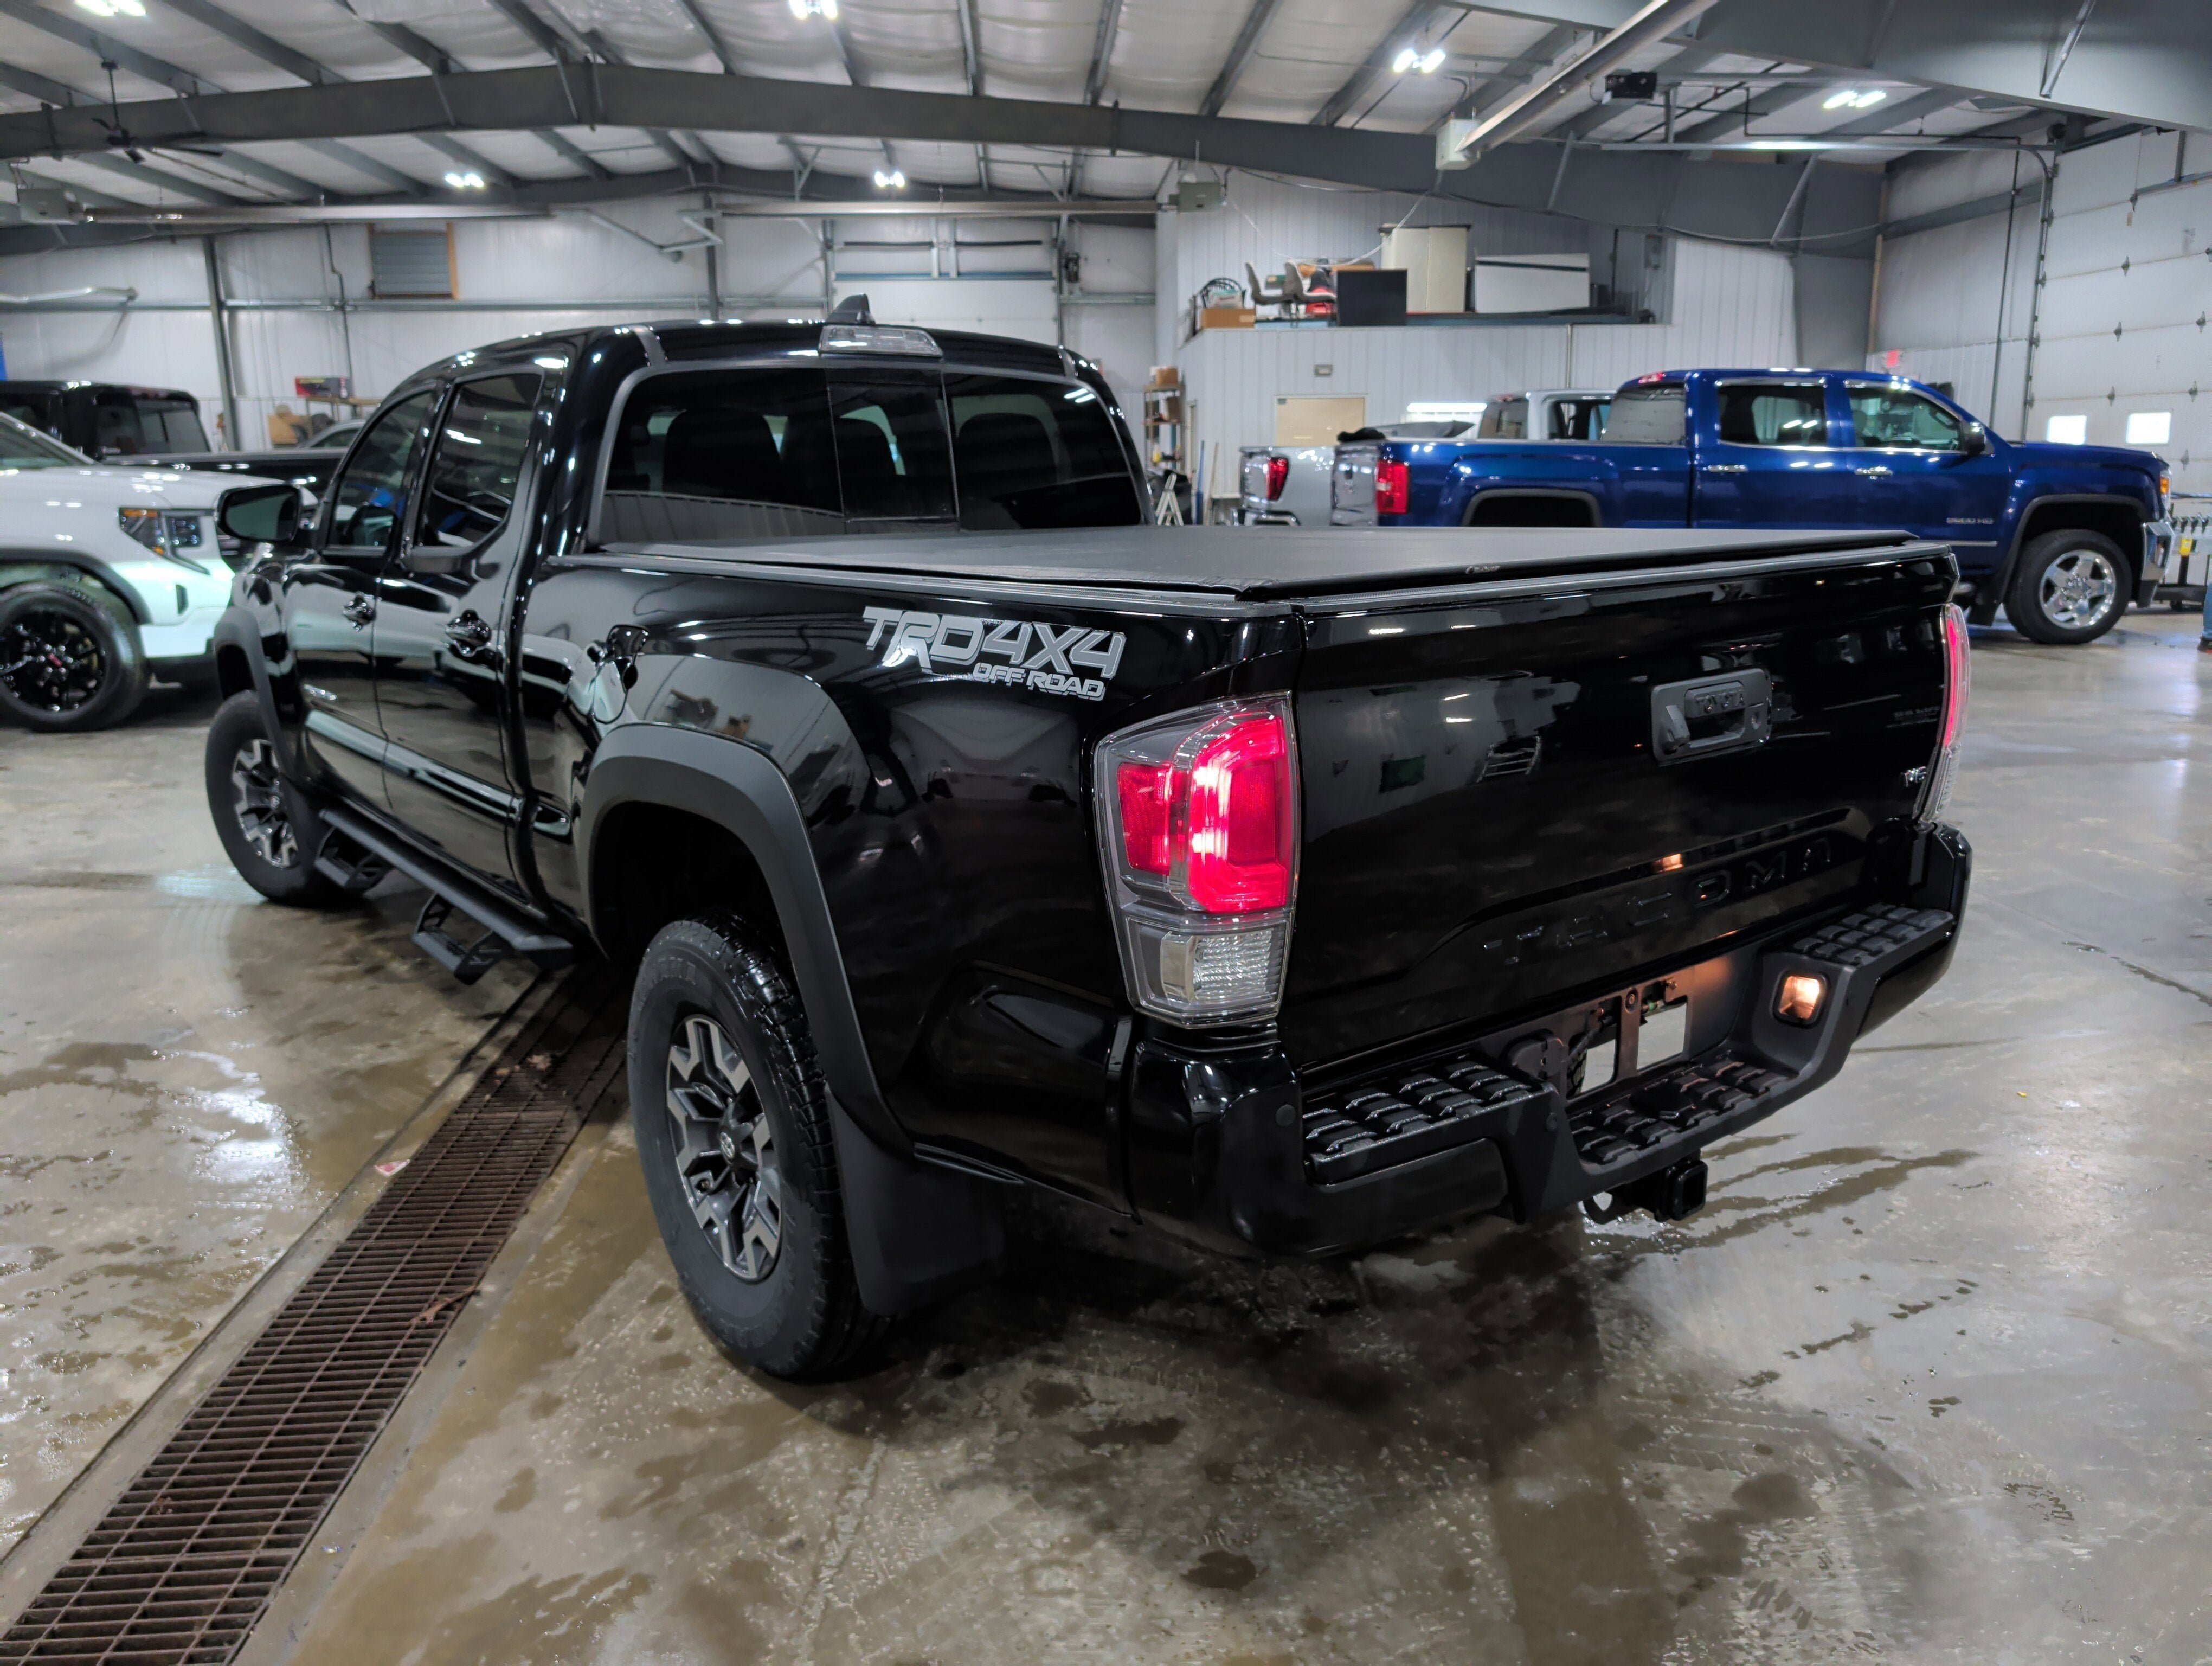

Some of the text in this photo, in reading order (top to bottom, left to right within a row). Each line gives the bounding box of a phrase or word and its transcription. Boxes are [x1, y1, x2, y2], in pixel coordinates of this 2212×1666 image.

[863, 606, 1127, 681] TRD 4X4
[972, 662, 1106, 702] OFF ROAD
